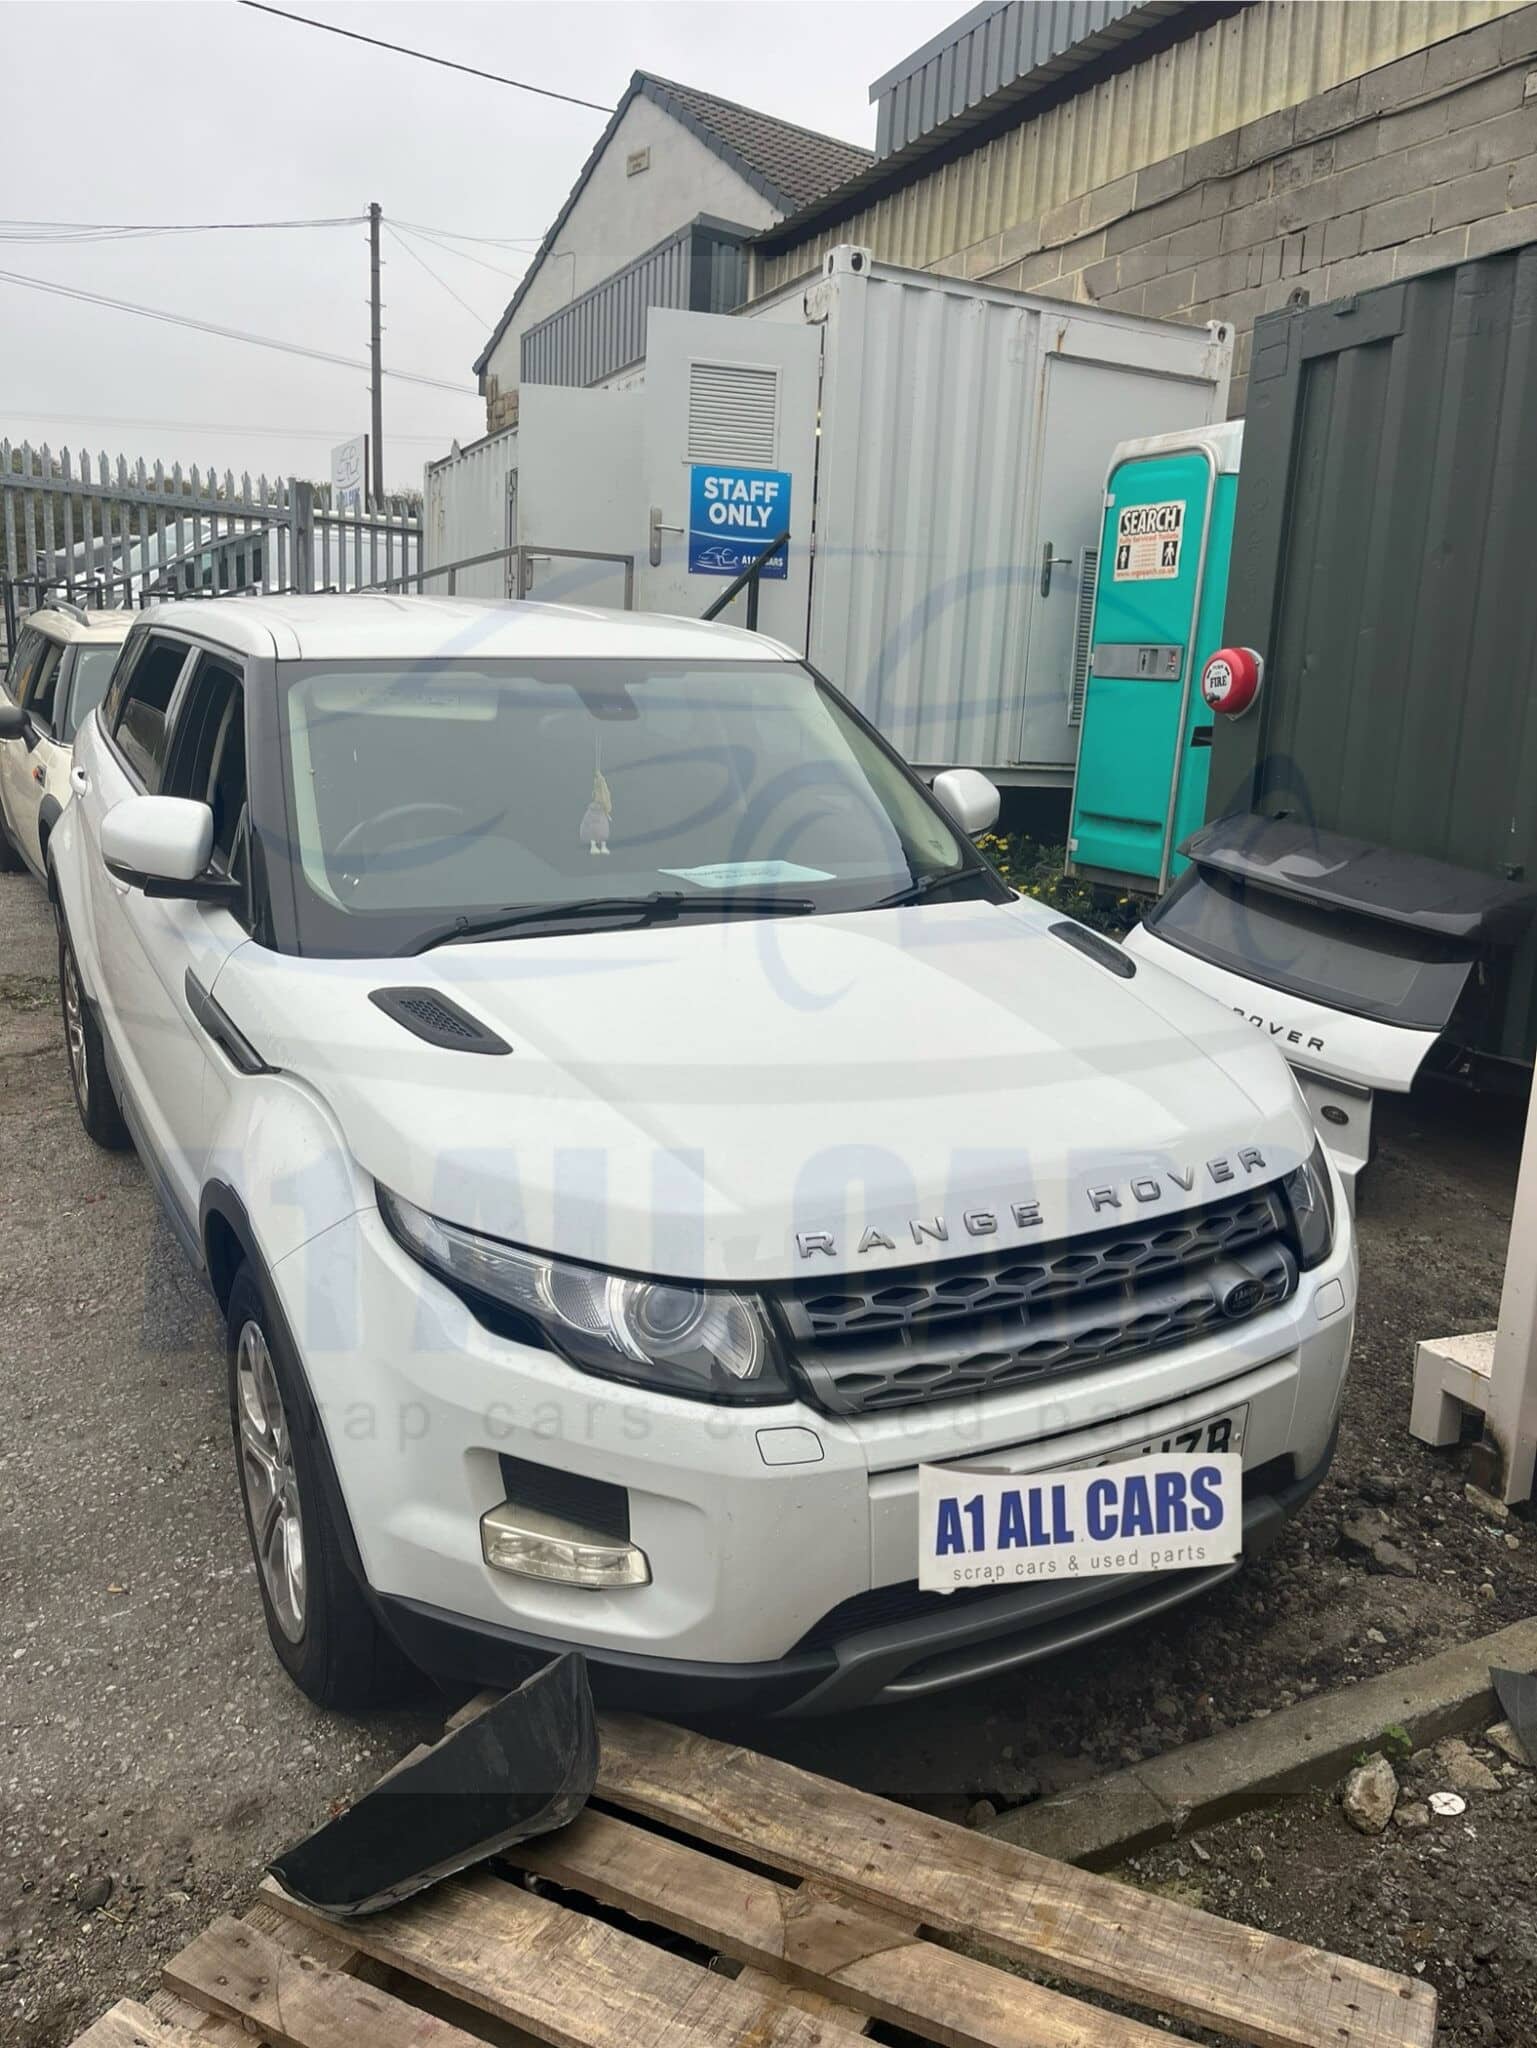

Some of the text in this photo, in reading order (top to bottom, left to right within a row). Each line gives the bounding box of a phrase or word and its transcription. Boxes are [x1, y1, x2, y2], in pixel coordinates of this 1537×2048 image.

[704, 476, 779, 503] STAFF
[709, 502, 773, 528] ONLY
[1123, 505, 1178, 536] SEARCH
[1210, 676, 1227, 688] FIRE
[795, 1146, 1267, 1259] RANGE ROVER
[935, 1465, 1224, 1556] A1 ALL CARS
[953, 1544, 1206, 1582] scrap cars & used parts
